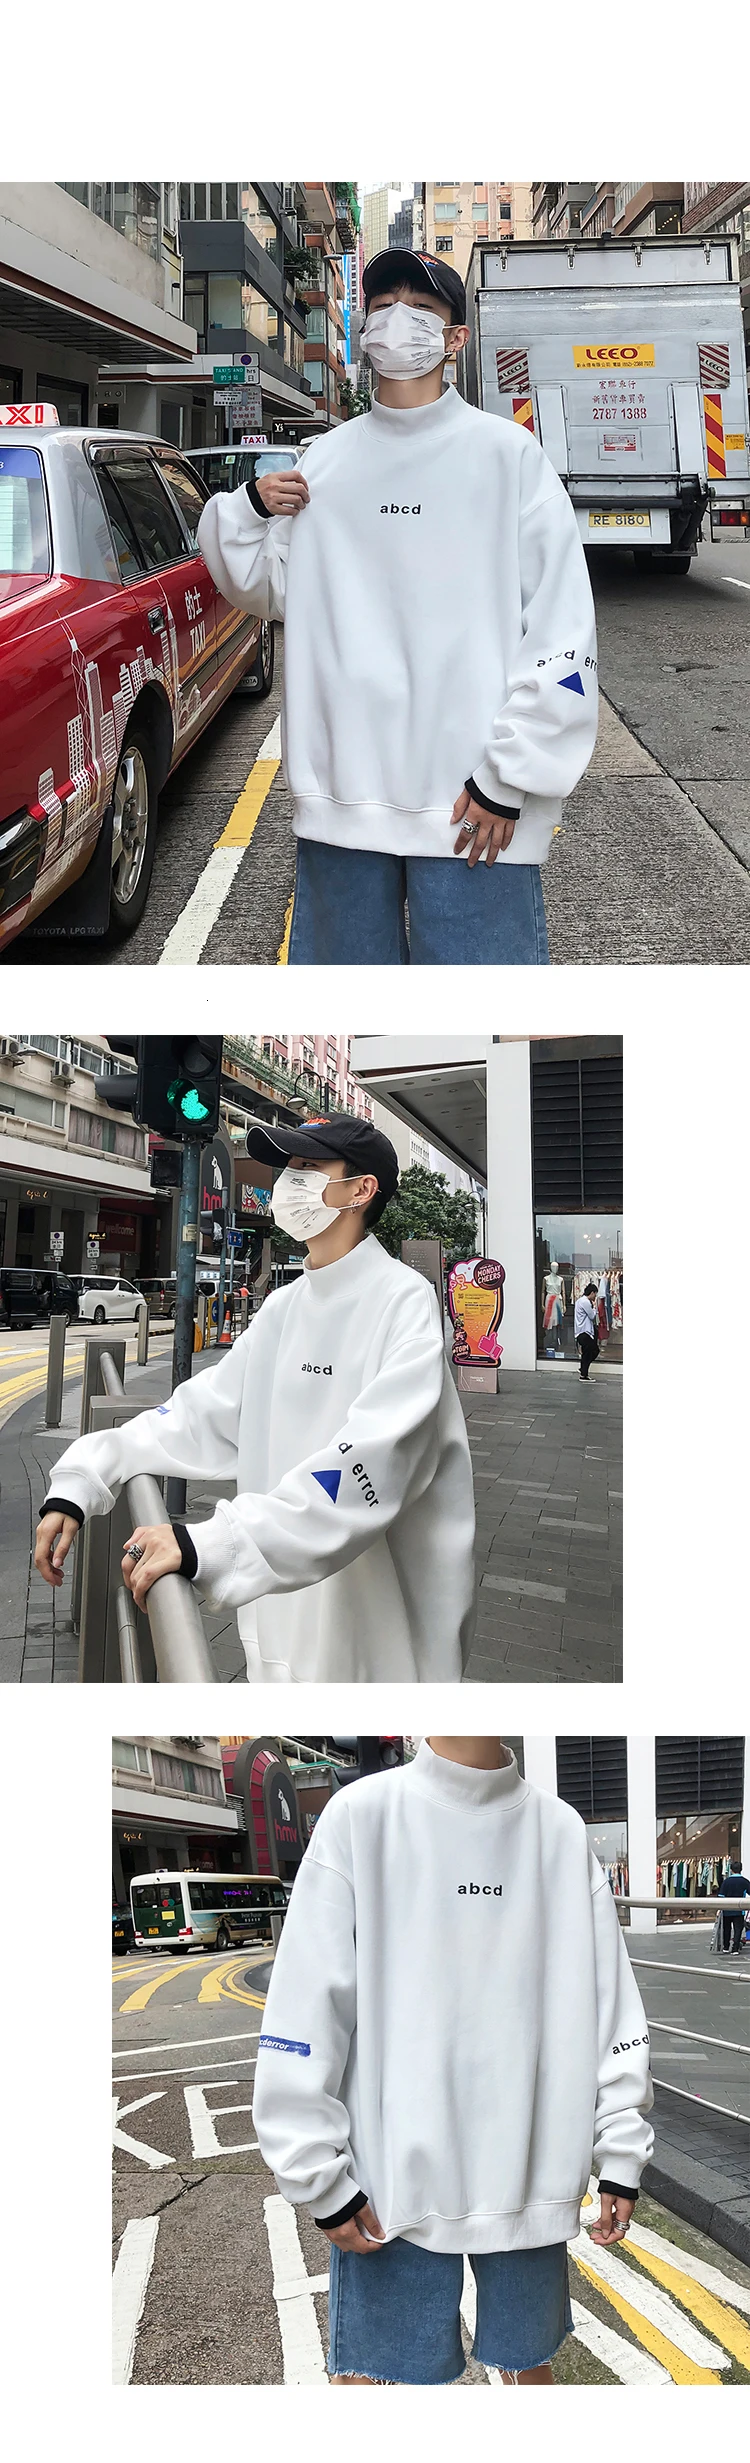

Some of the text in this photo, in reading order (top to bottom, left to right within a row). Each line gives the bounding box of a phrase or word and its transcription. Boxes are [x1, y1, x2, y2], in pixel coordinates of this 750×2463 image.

[585, 347, 639, 360] LEEO
[503, 364, 522, 377] LEEO
[705, 359, 724, 373] LEEO
[0, 404, 44, 426] XI
[592, 408, 647, 420] 2787 1388
[243, 436, 265, 445] TAXI
[380, 503, 421, 515] abcd
[593, 514, 645, 525] RE 8180
[184, 586, 203, 621] 的士
[189, 620, 206, 659] TAXI
[33, 926, 105, 935] TOYOTA LPG TAXI
[477, 1265, 501, 1277] MONDAY
[477, 1272, 502, 1284] CHEERS
[301, 1362, 333, 1376] abcd
[352, 1462, 379, 1508] error
[274, 1822, 298, 1843] hmv
[457, 1882, 503, 1896] abcd
[612, 2034, 650, 2054] abcd
